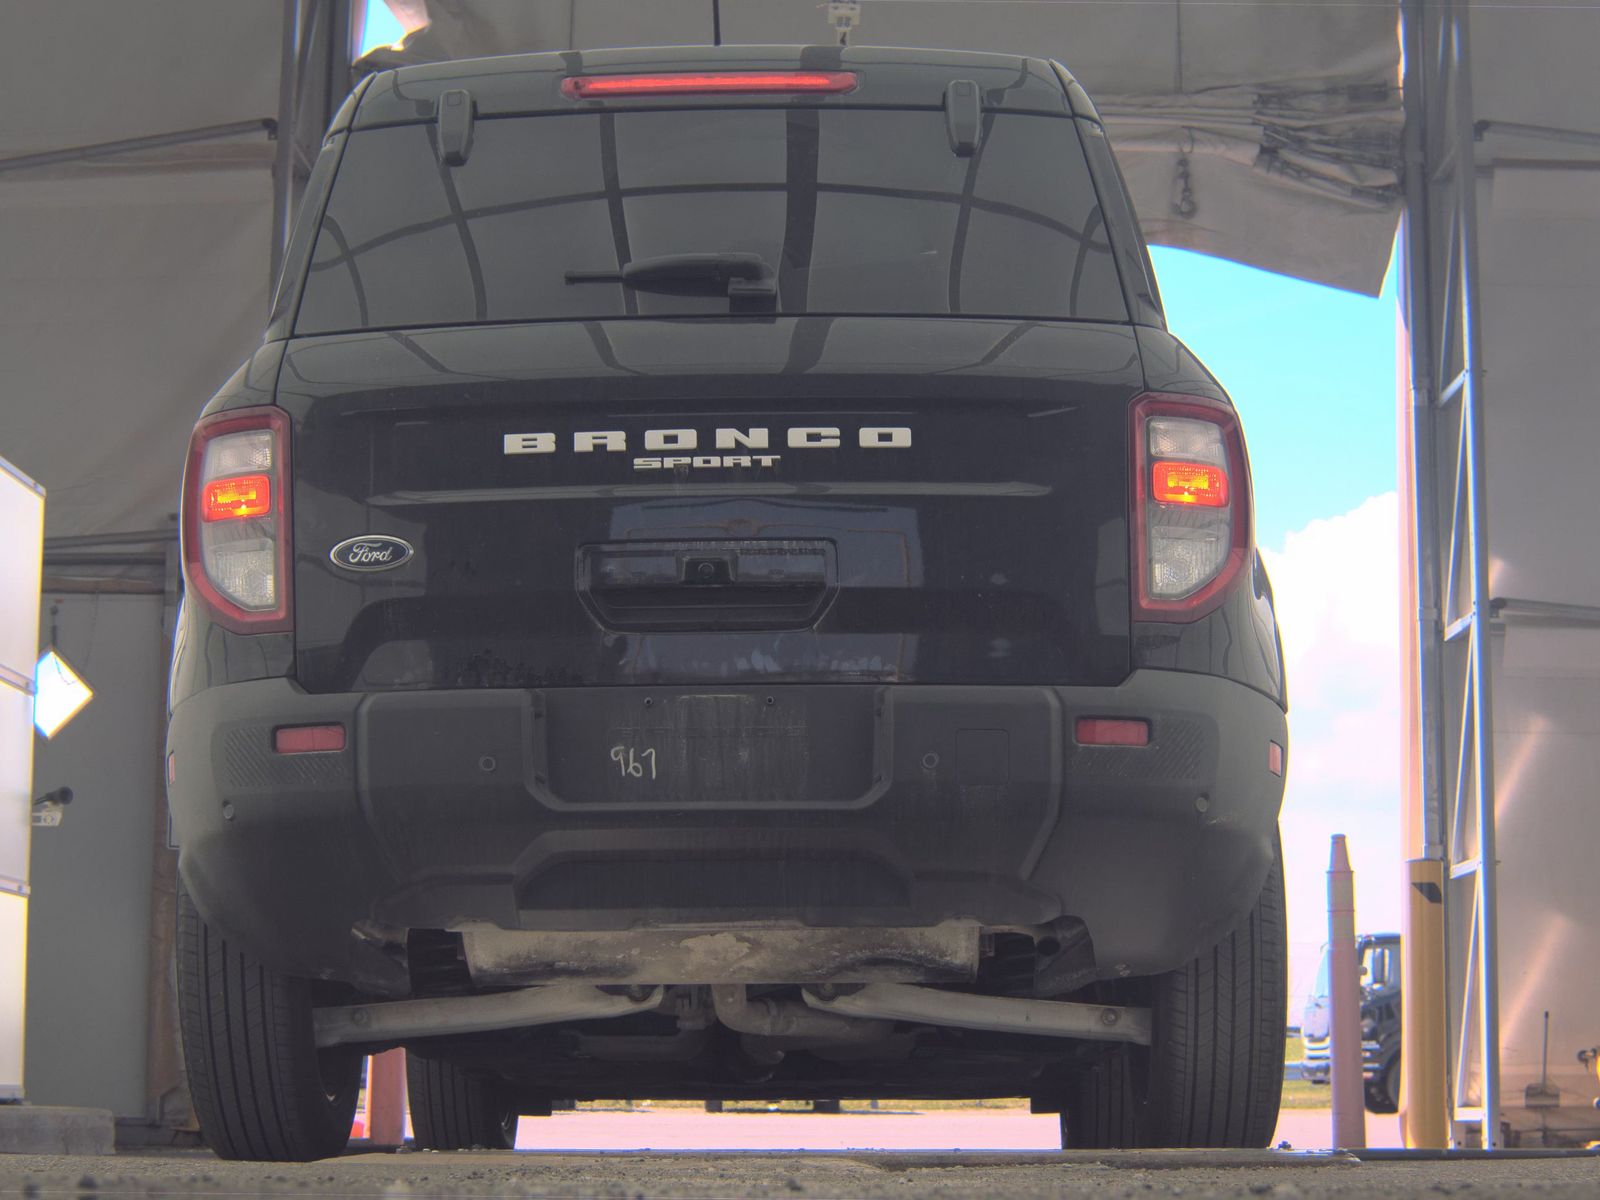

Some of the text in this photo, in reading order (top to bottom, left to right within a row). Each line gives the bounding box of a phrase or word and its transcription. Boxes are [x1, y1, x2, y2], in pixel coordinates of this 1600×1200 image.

[503, 427, 912, 455] BRONCO
[633, 455, 781, 470] SPORT
[348, 542, 393, 563] Ford
